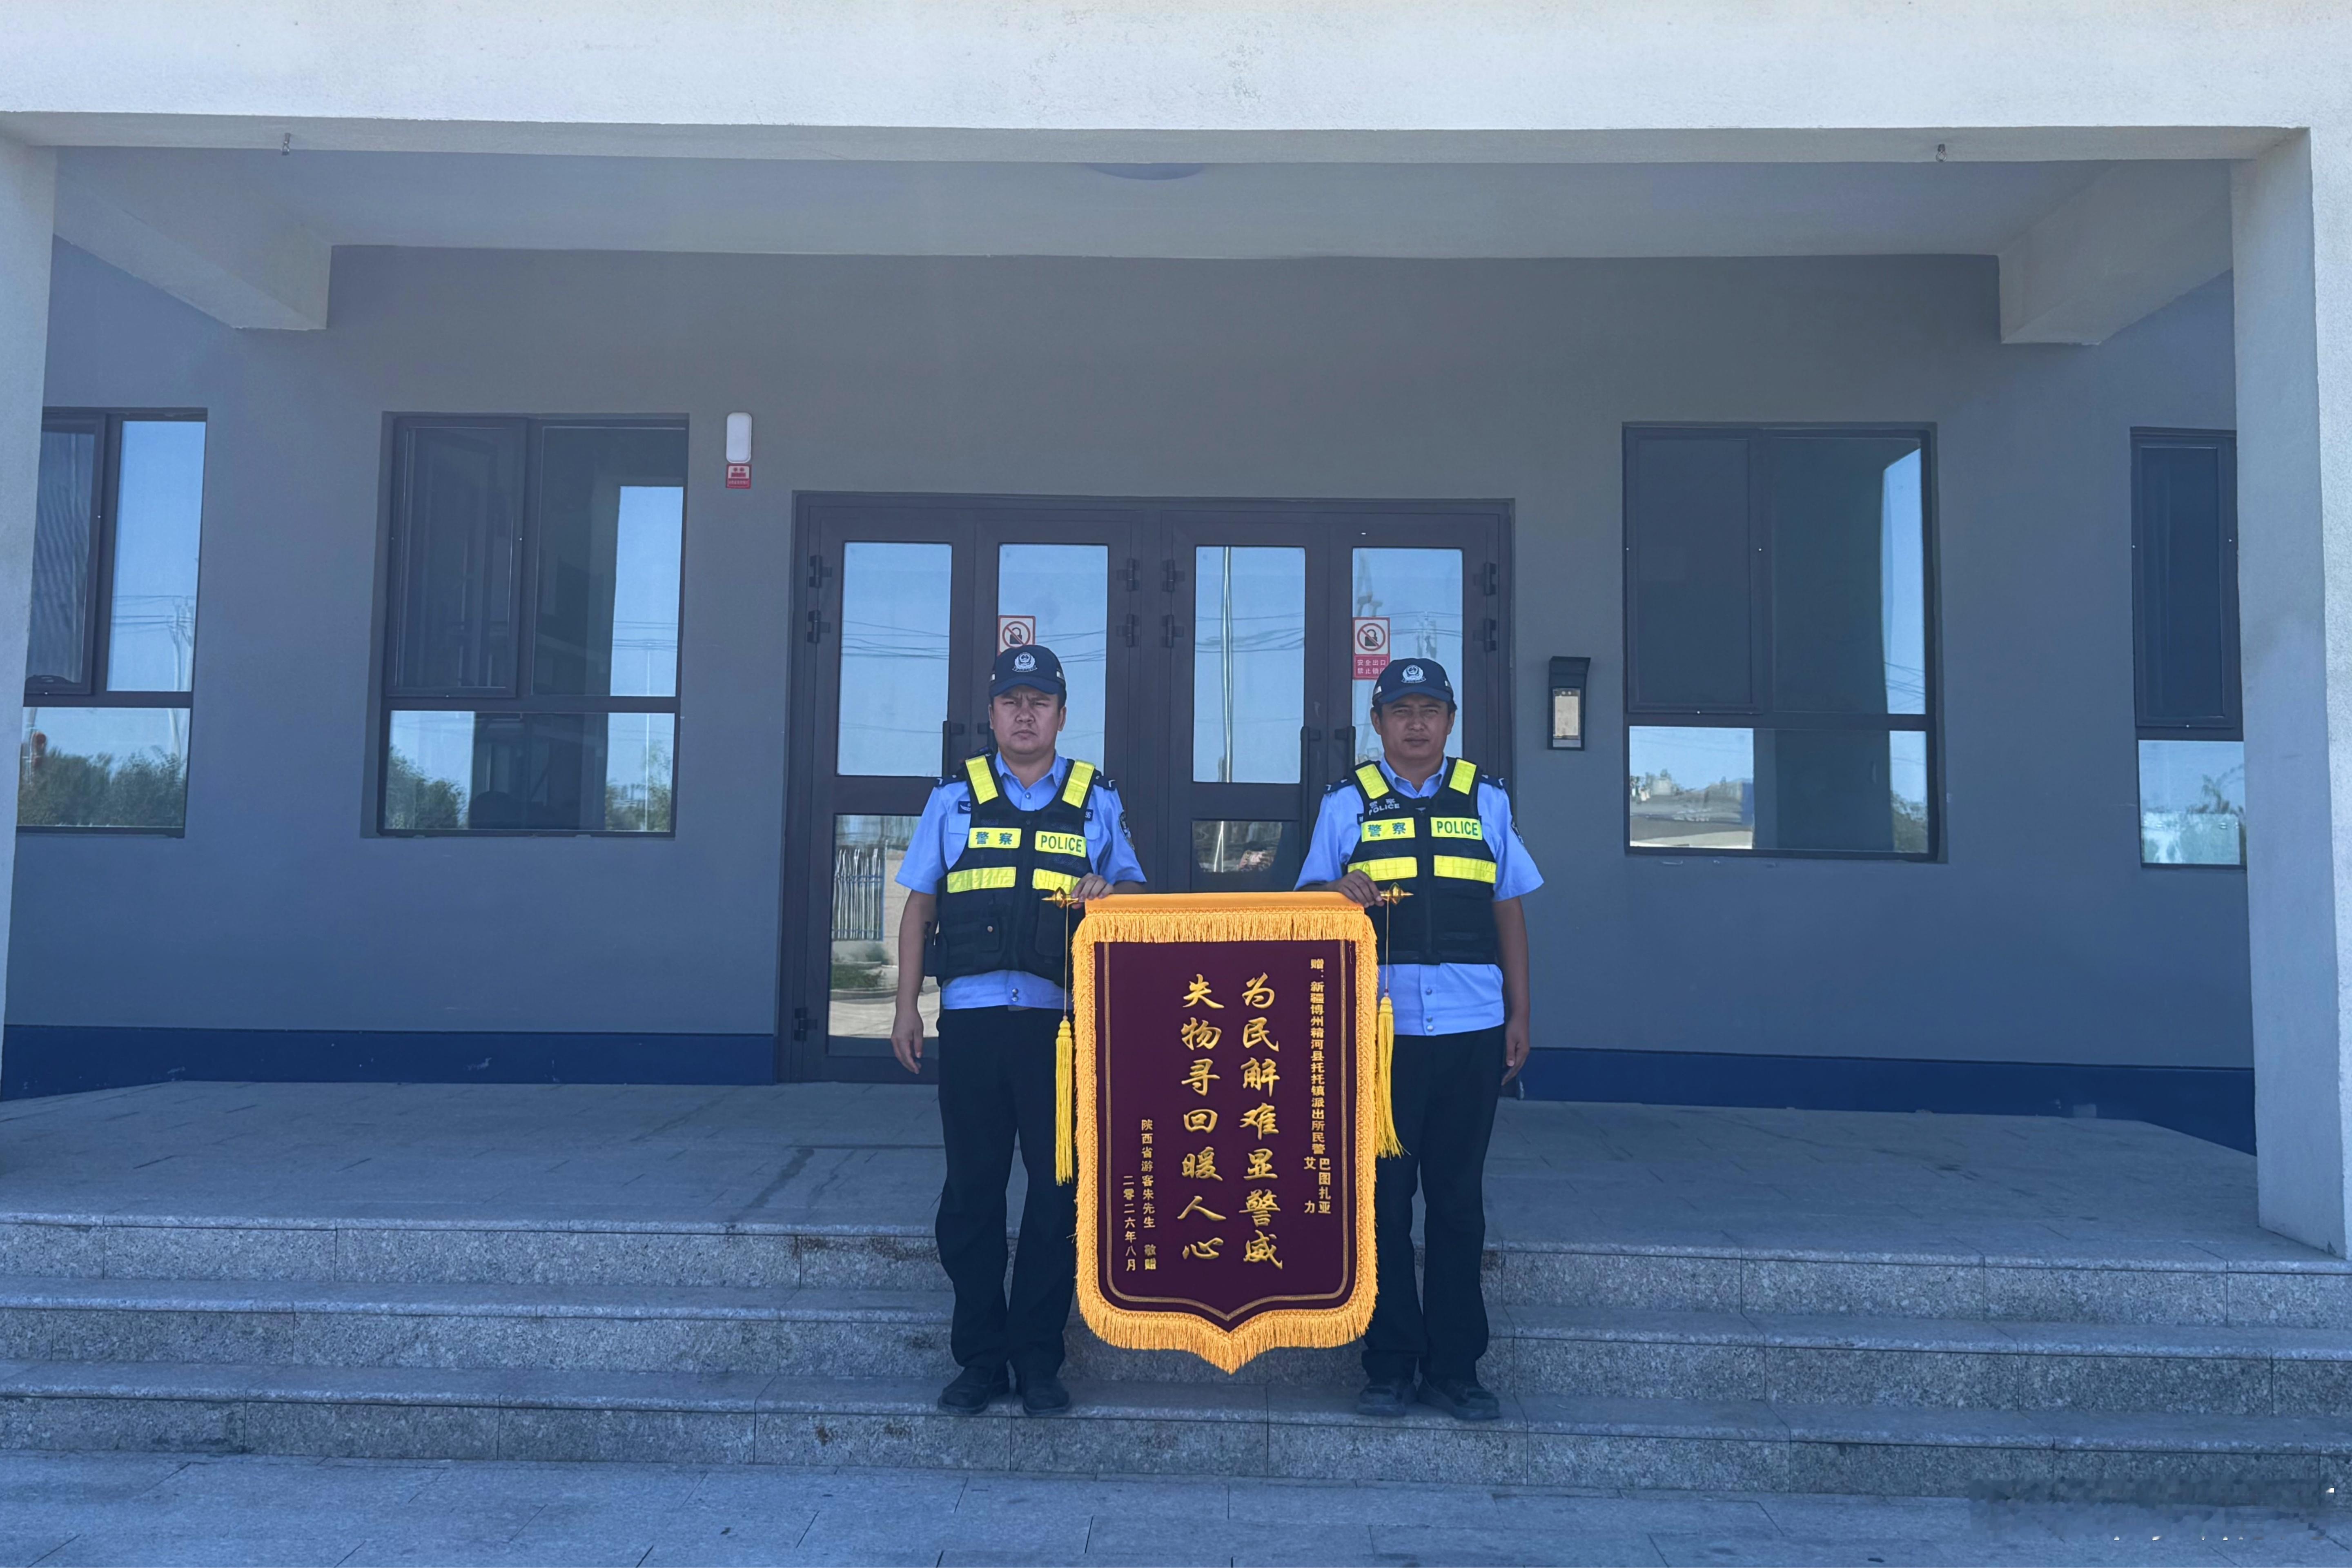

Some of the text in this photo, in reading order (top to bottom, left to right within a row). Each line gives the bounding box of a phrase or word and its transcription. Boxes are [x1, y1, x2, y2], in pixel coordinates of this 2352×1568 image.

[976, 831, 1013, 845] 警察
[1041, 835, 1082, 853] POLICE
[1368, 822, 1406, 837] 警察
[1437, 821, 1478, 836] POLICE
[1177, 973, 1227, 1259] 失物寻回暖人心
[1238, 972, 1283, 1269] 为民解难显警威
[1141, 1119, 1155, 1228] 陕西省游客朱先生
[1318, 1158, 1331, 1214] 巴图扎亚
[1123, 1176, 1136, 1271] 二零二六年八月
